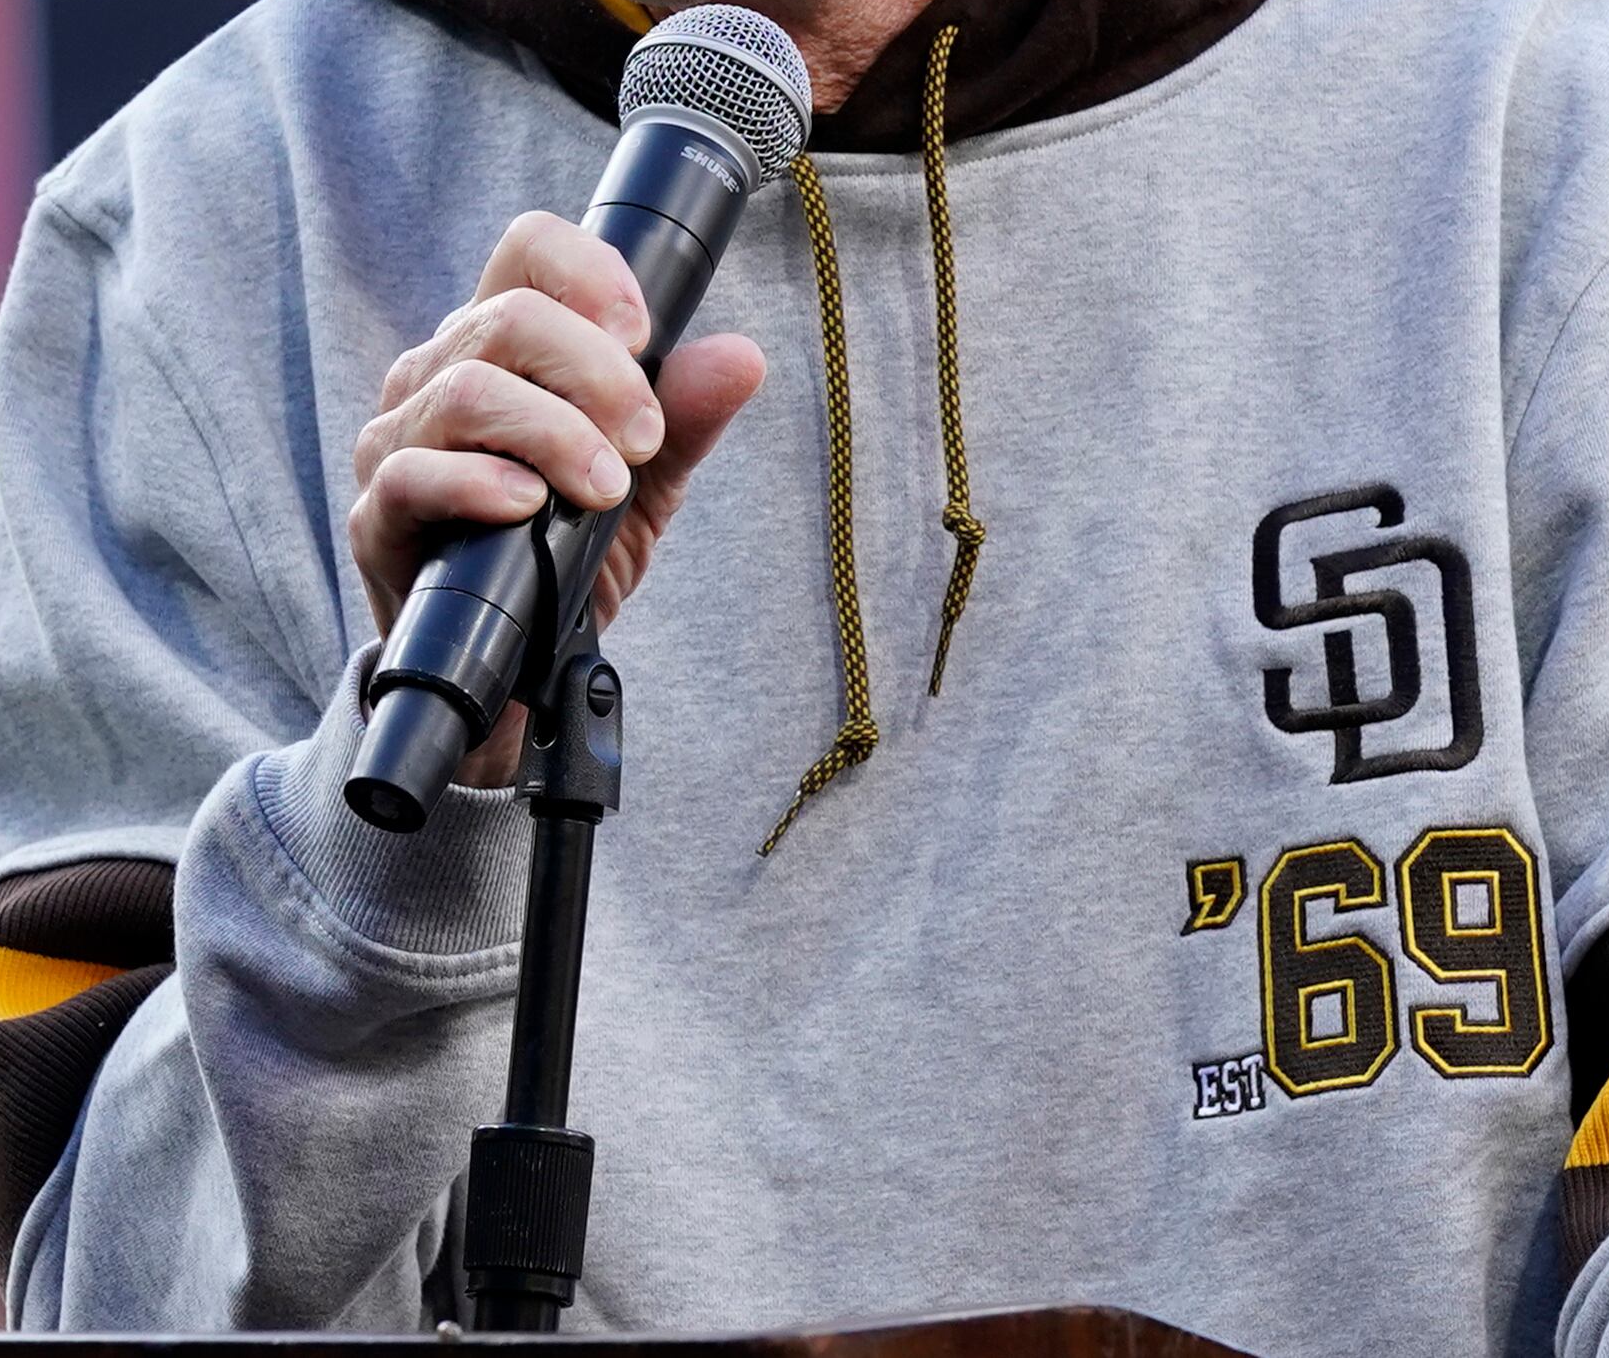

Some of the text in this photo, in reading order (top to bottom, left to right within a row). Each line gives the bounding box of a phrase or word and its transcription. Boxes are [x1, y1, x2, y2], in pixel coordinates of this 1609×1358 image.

[680, 145, 737, 193] SHURE
[1252, 483, 1485, 785] SD
[1194, 1053, 1265, 1119] EST
